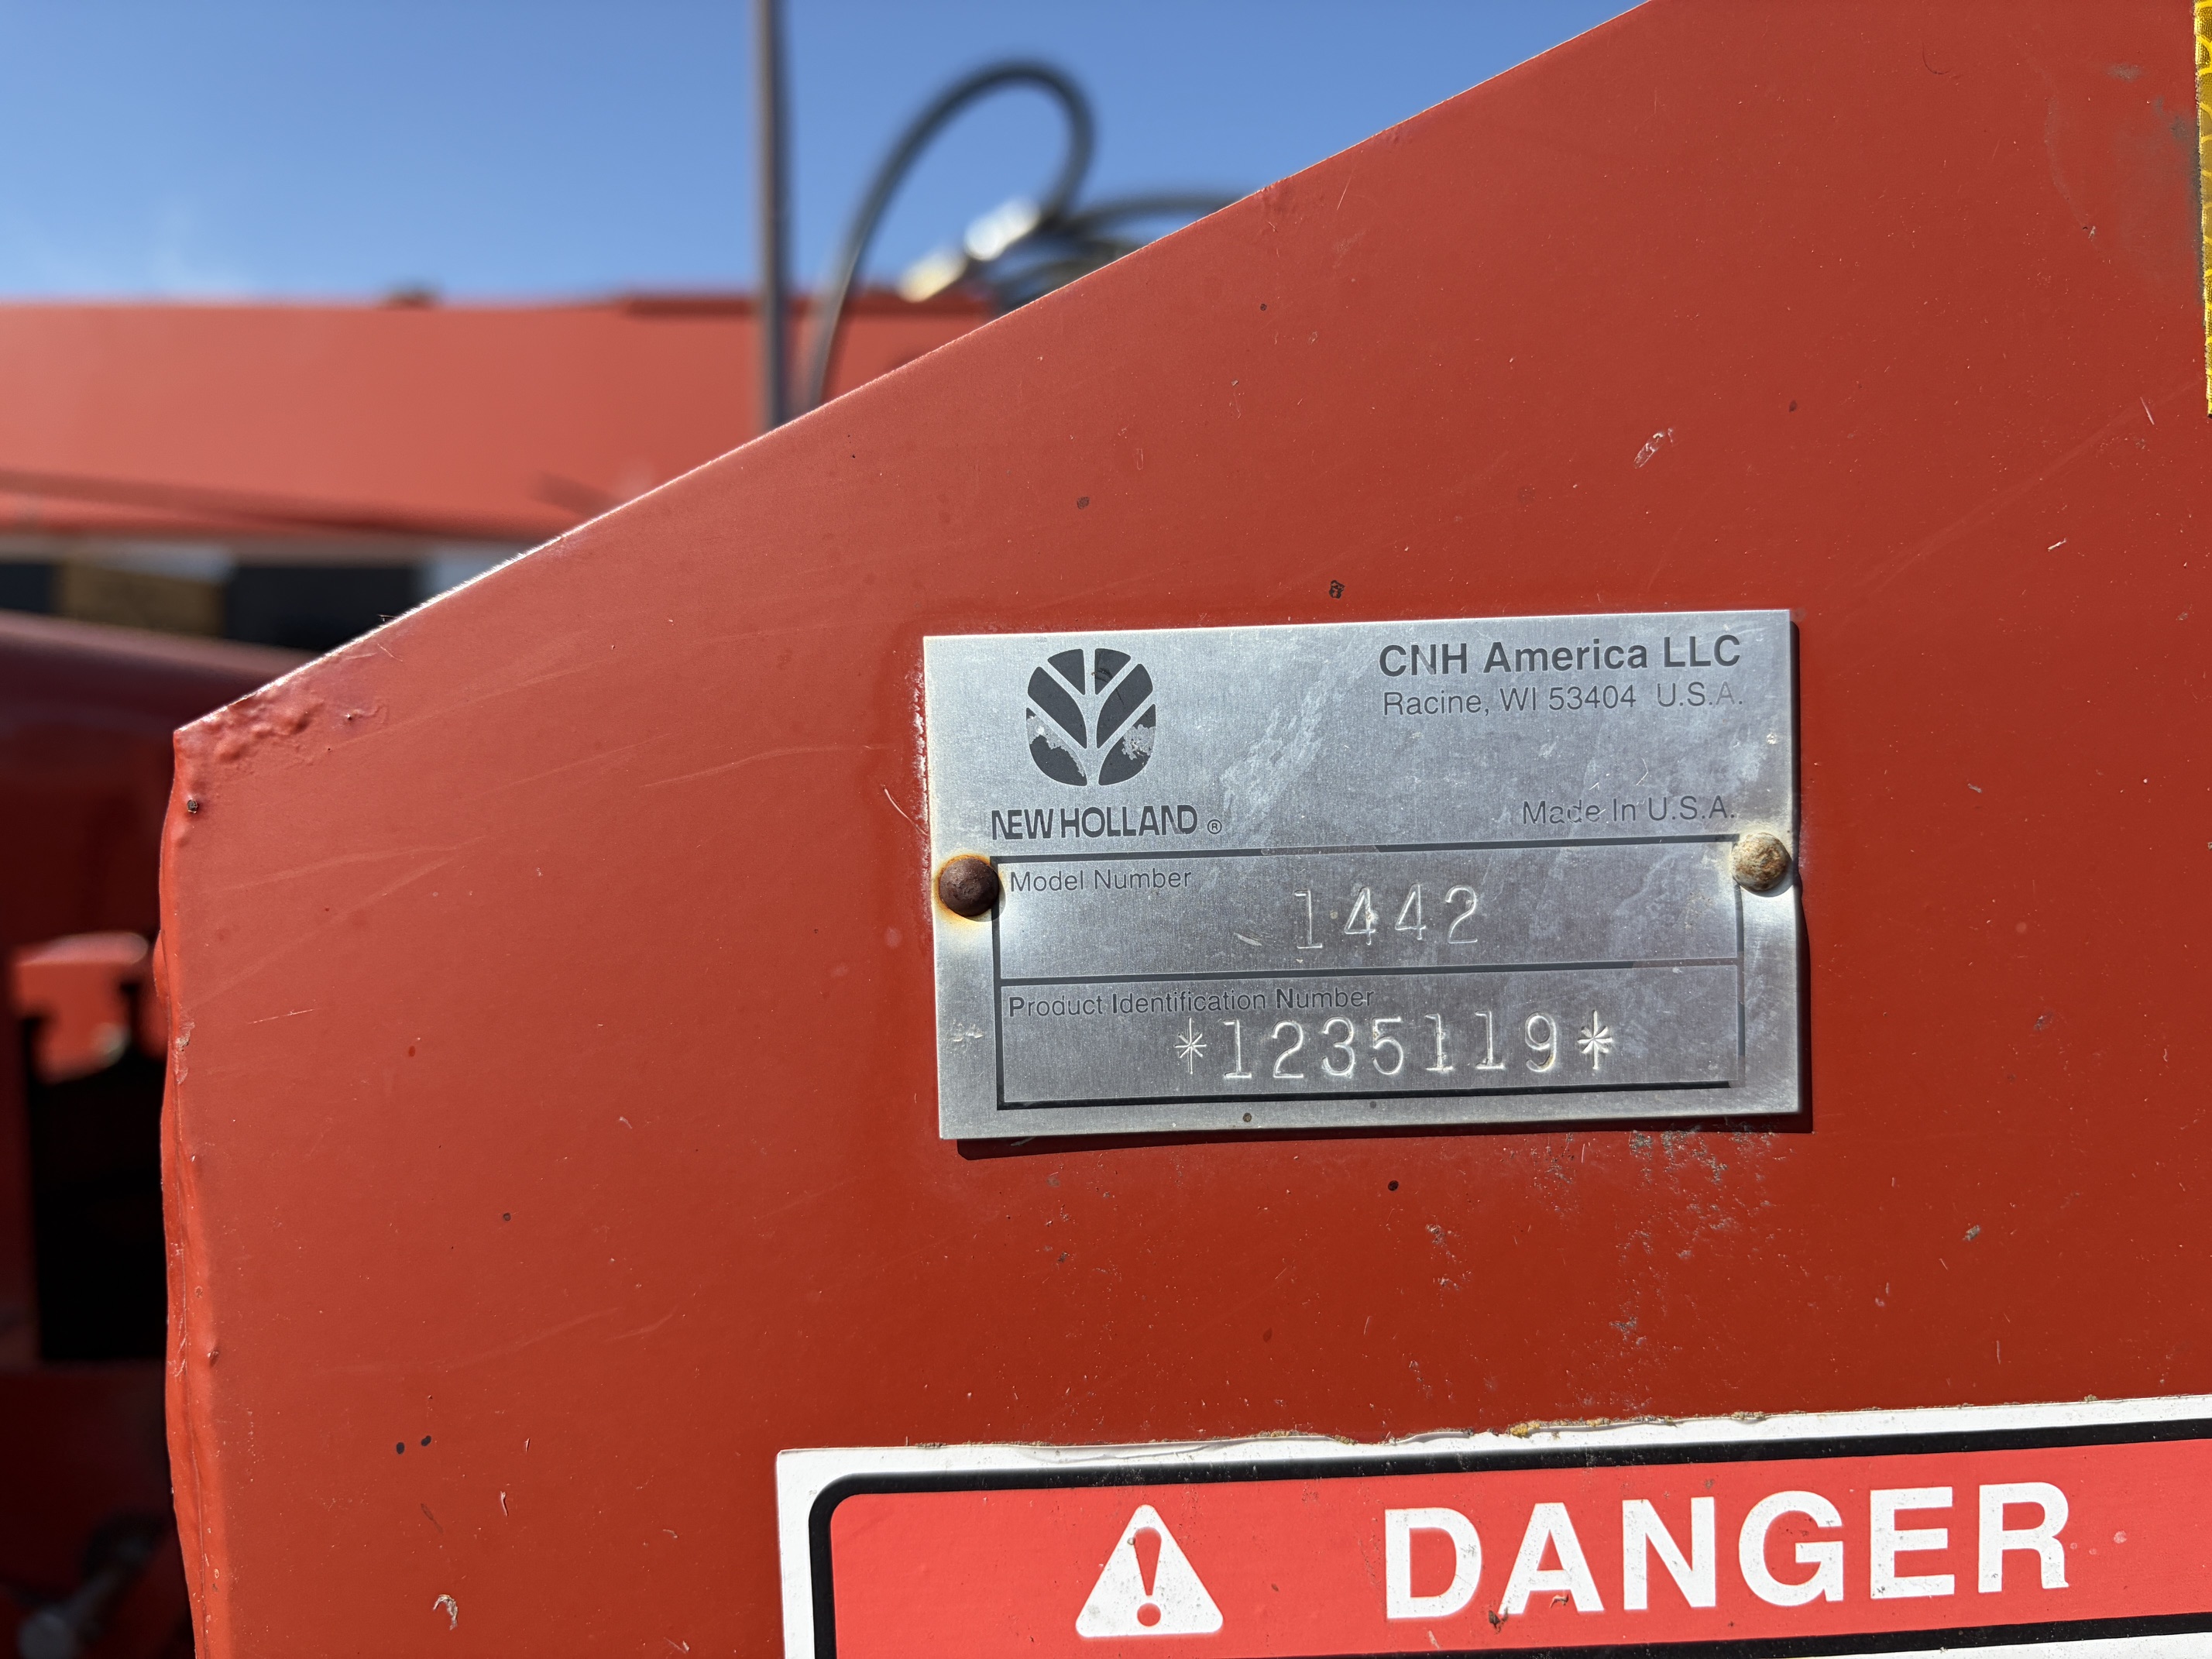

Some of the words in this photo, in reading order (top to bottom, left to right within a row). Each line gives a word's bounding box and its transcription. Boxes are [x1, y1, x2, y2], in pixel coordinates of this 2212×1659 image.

[1379, 644, 1468, 676] CNH
[1483, 639, 1648, 673] America
[1664, 634, 1741, 668] LLC
[1384, 689, 1489, 716] Racine,
[1499, 687, 1537, 711] WI
[1549, 685, 1637, 710] 53404
[1657, 681, 1743, 707] U.S.A.
[991, 808, 1054, 840] NEW
[1061, 804, 1198, 838] HOLLAND
[1523, 799, 1600, 825] Made
[1613, 798, 1637, 822] In
[1648, 795, 1735, 821] U.S.A.
[1010, 869, 1084, 892] Model
[1094, 867, 1192, 891] Number
[1293, 882, 1479, 950] 1442
[1008, 991, 1104, 1018] Product
[1112, 989, 1266, 1015] Identification
[1276, 986, 1375, 1010] Number
[1385, 1481, 2070, 1621] DANGER
